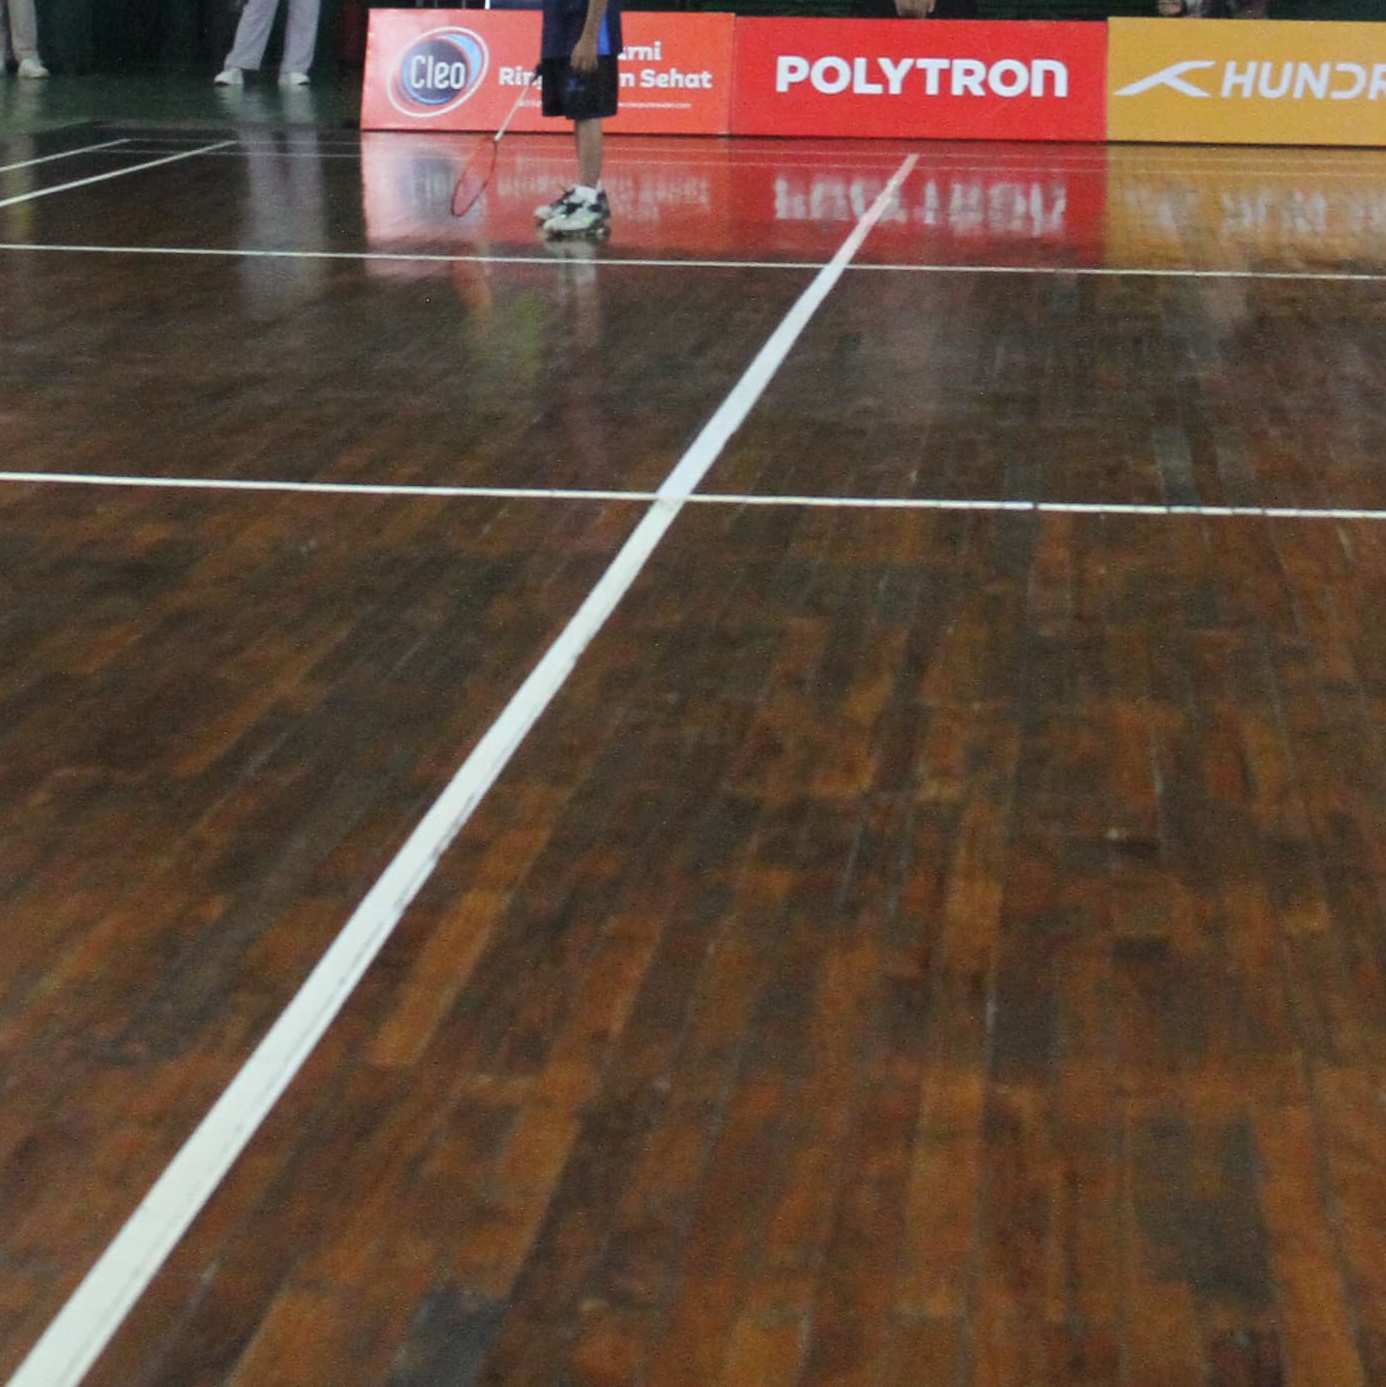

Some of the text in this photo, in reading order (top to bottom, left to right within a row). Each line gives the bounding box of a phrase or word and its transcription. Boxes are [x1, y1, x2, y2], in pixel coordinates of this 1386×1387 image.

[410, 54, 466, 90] Cleo
[640, 68, 713, 89] Sehat
[774, 56, 1069, 98] POLYTRON
